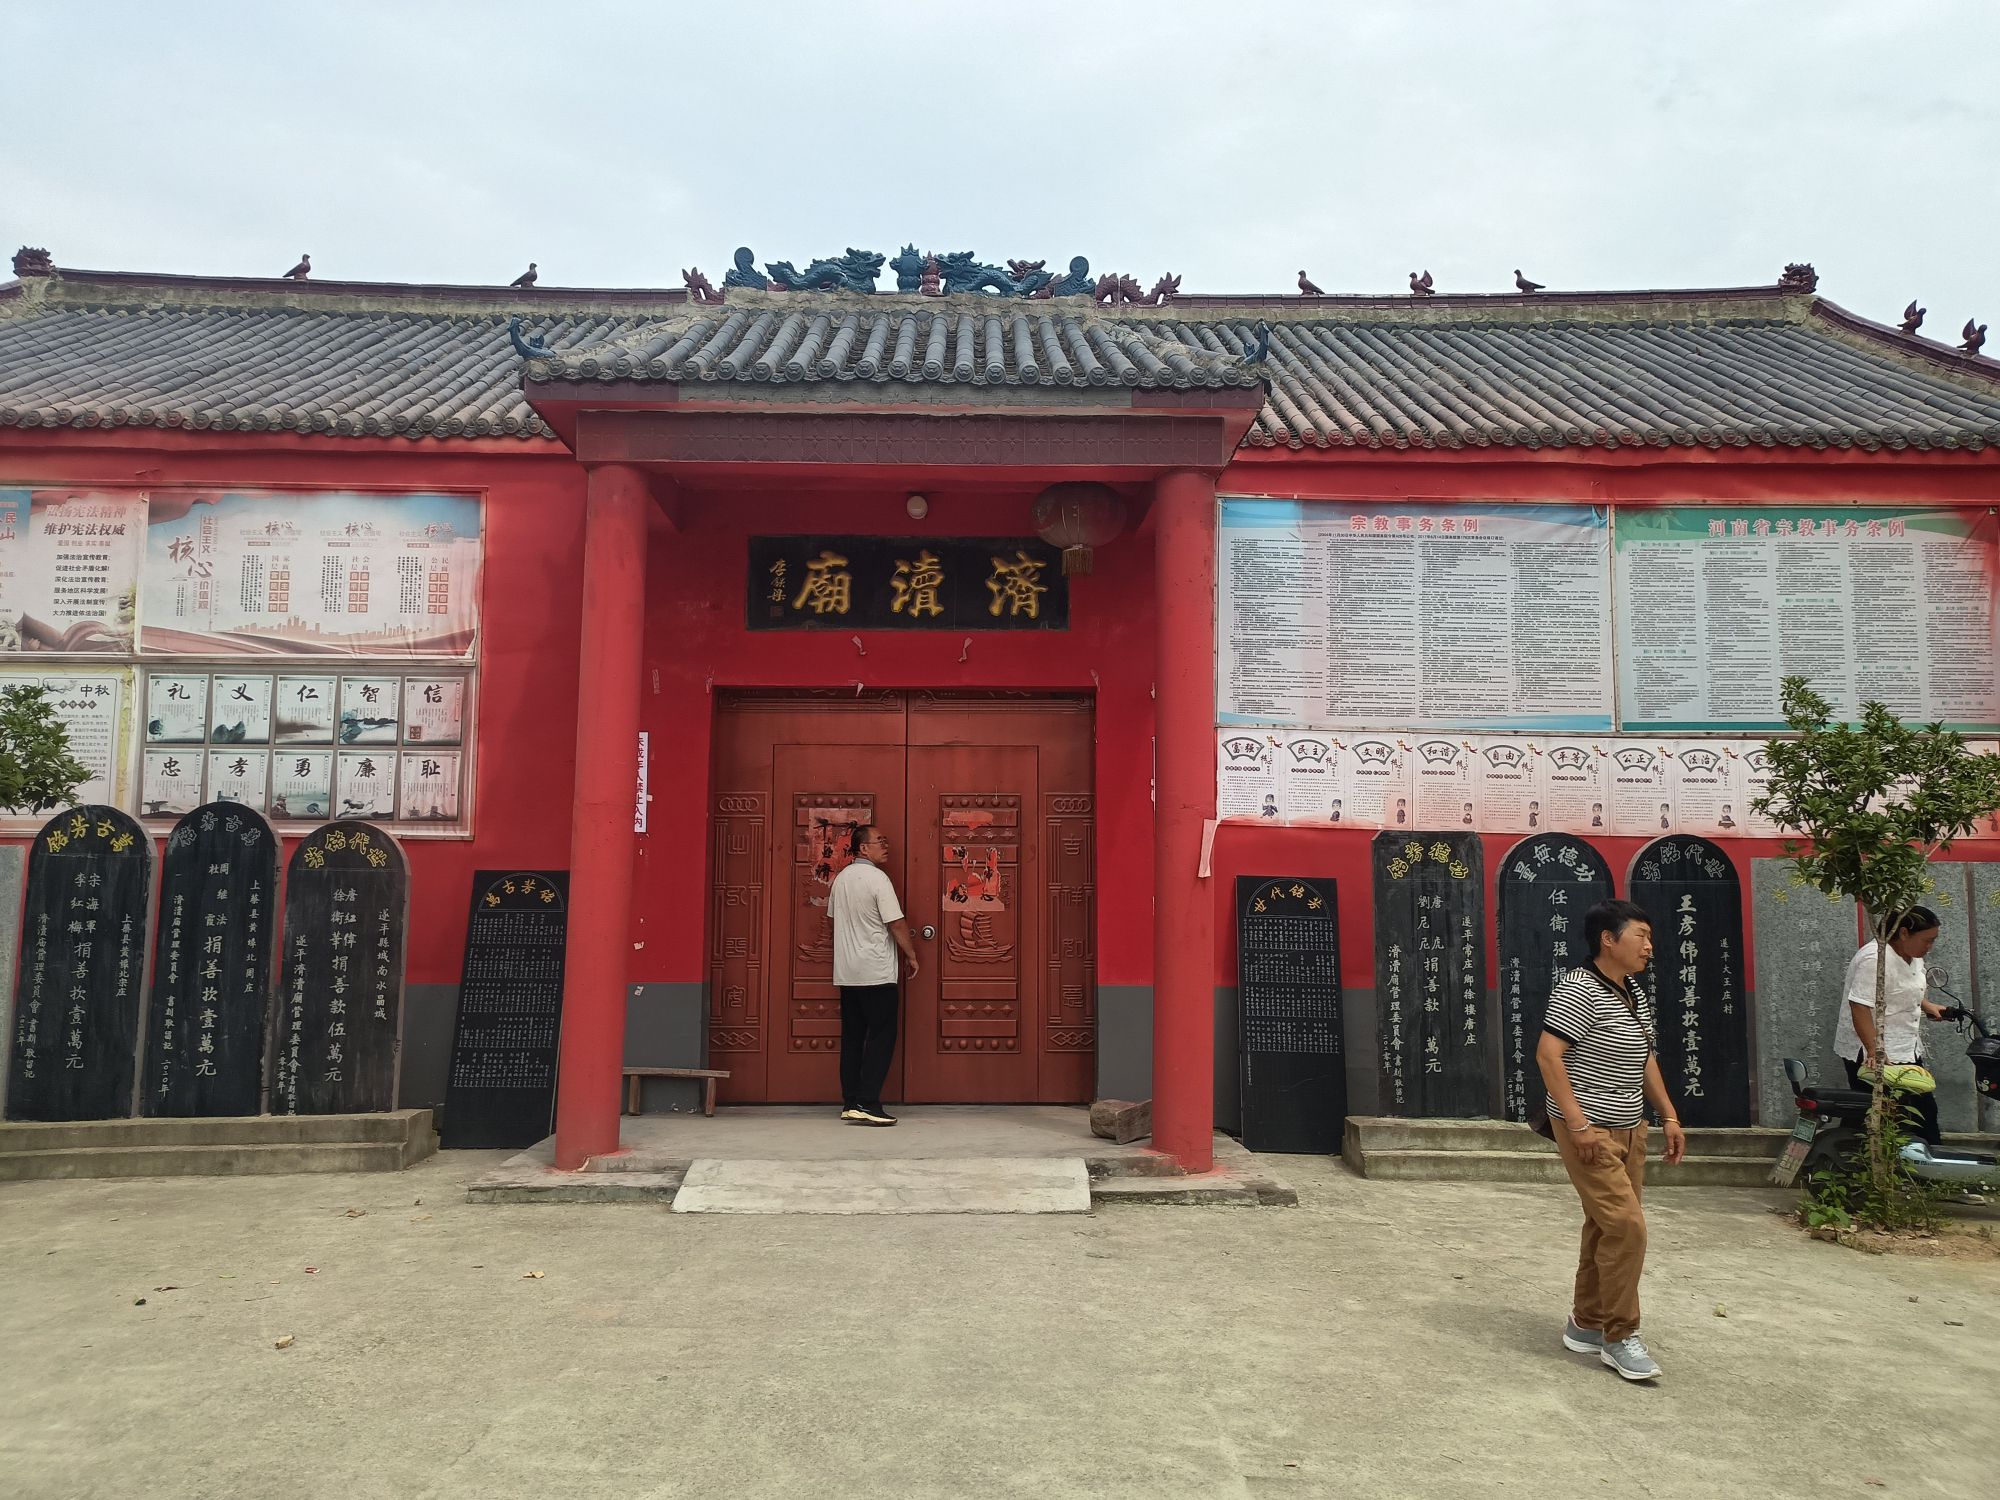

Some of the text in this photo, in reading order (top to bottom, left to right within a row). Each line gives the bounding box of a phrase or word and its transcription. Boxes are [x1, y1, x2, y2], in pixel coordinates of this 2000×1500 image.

[46, 504, 127, 519] 弘扬宪法精神
[44, 523, 126, 536] 维护宪法权威
[1351, 516, 1479, 532] 宗教事务条例
[1708, 519, 1905, 537] 河南省宗教事务条例
[201, 516, 213, 554] 社会主义
[168, 536, 213, 578] 核心
[198, 581, 209, 610] 价值观
[80, 684, 110, 697] 中秋
[167, 683, 190, 700] 礼
[231, 683, 254, 701] 义
[297, 685, 319, 702] 仁
[360, 684, 380, 703] 智
[424, 684, 443, 703] 信
[1232, 742, 1254, 754] 富强
[1298, 744, 1319, 756] 民主
[1362, 747, 1385, 758] 文明
[1427, 746, 1450, 757] 和谐
[1493, 750, 1514, 761] 自由
[1557, 751, 1581, 762] 平等
[161, 757, 181, 776] 忠
[1622, 753, 1646, 763] 公正
[1689, 754, 1710, 765] 法治
[229, 757, 248, 777] 孝
[293, 758, 311, 777] 勇
[355, 758, 376, 778] 廉
[421, 759, 441, 779] 耻
[1513, 844, 1596, 883] 功德無量
[1720, 937, 1734, 1015] 遂平大王庄村
